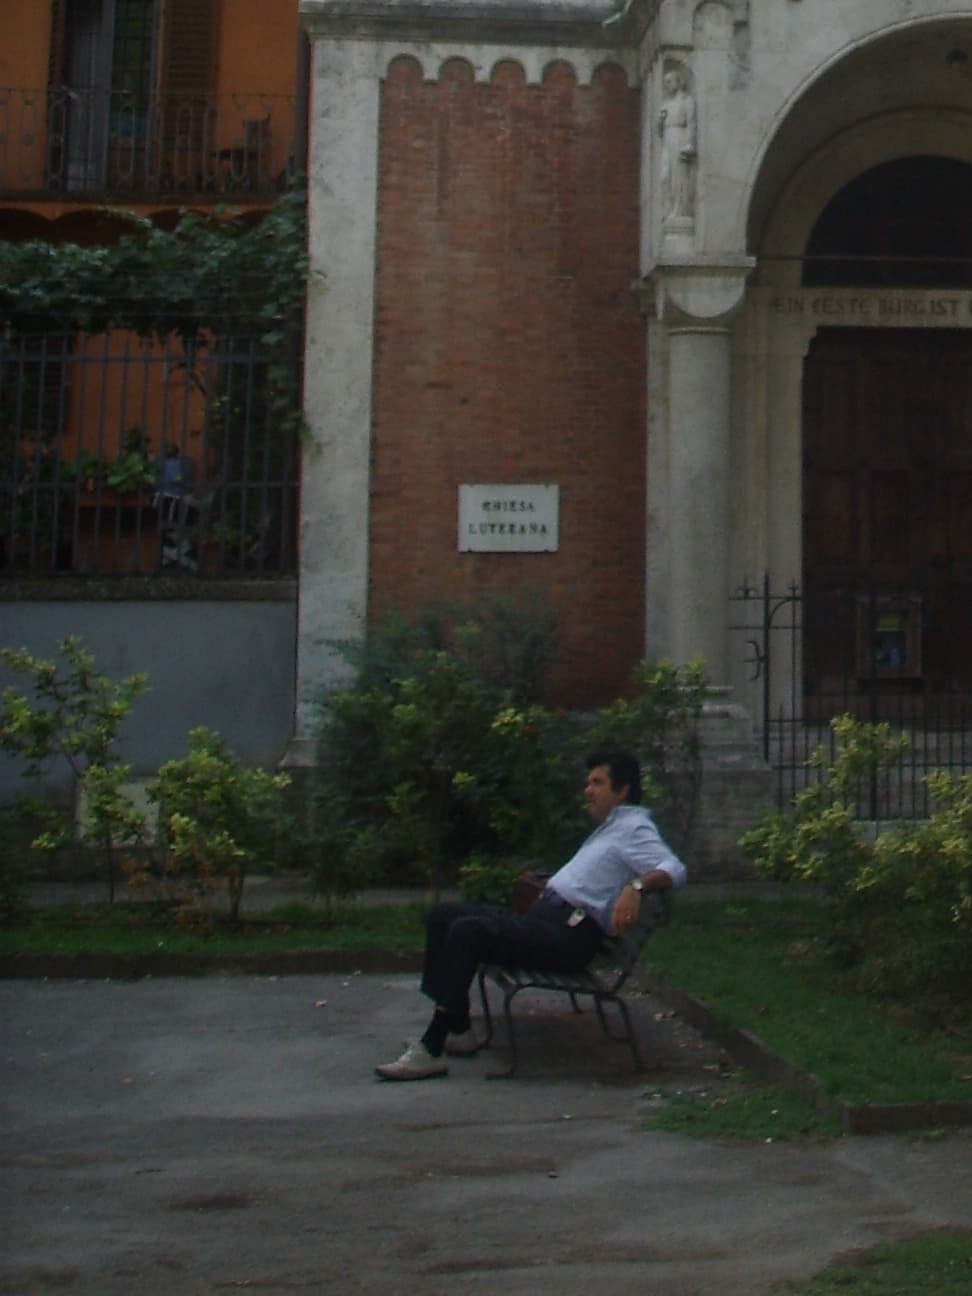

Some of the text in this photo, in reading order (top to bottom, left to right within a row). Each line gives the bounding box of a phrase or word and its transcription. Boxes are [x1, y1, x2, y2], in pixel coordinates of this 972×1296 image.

[930, 299, 960, 315] IST
[481, 500, 536, 512] CHIESA
[467, 523, 548, 535] LUTERANA
